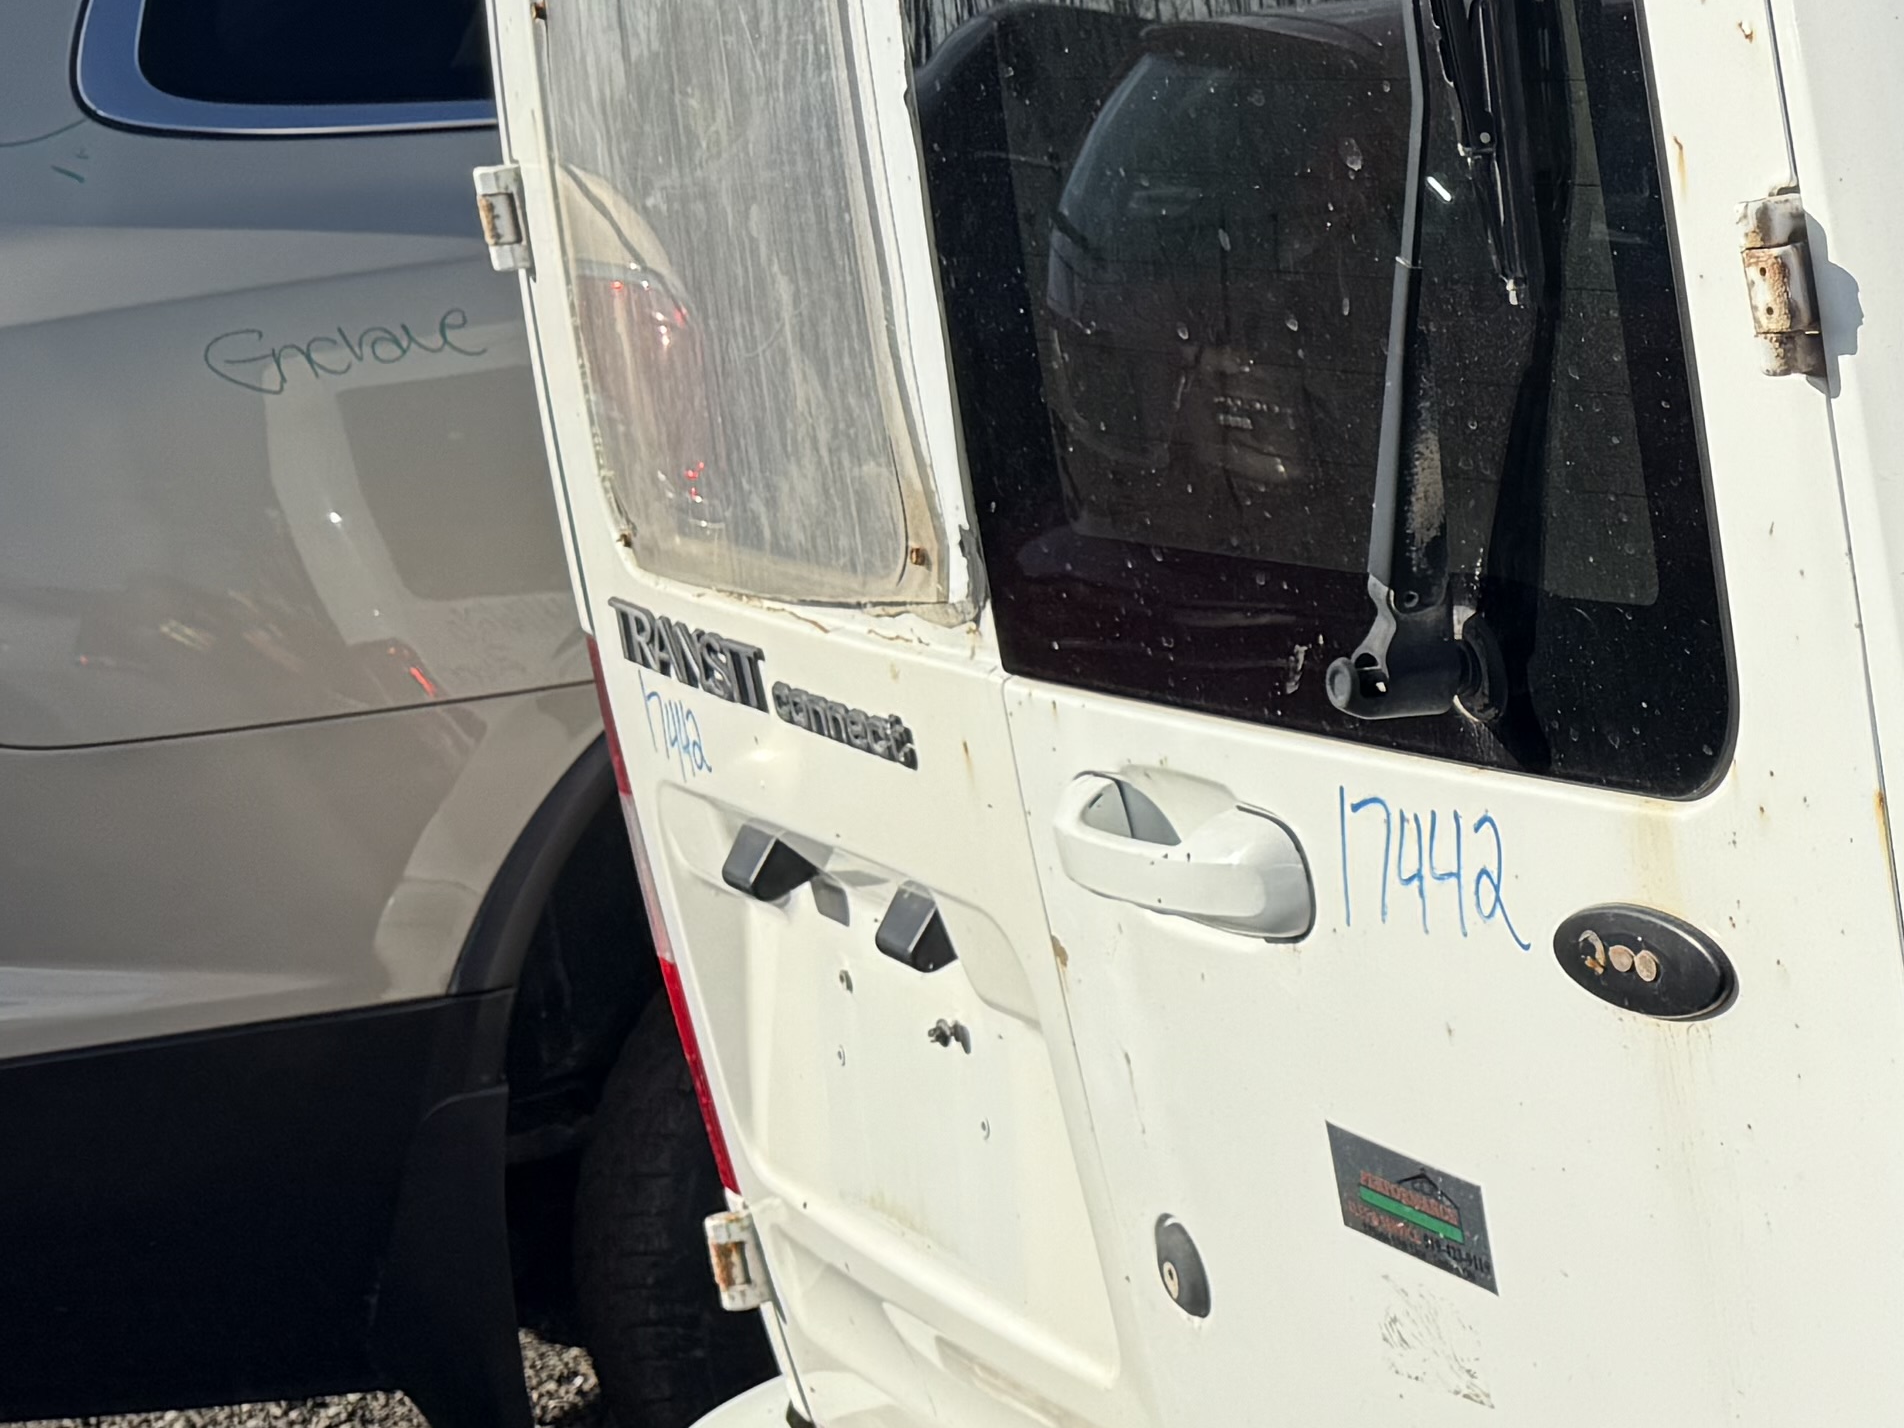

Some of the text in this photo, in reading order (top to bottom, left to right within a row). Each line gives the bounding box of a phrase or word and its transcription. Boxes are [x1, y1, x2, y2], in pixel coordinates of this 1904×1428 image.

[204, 307, 487, 394] Enclave
[608, 596, 919, 771] TRANSIT connect
[1340, 786, 1531, 950] 17442
